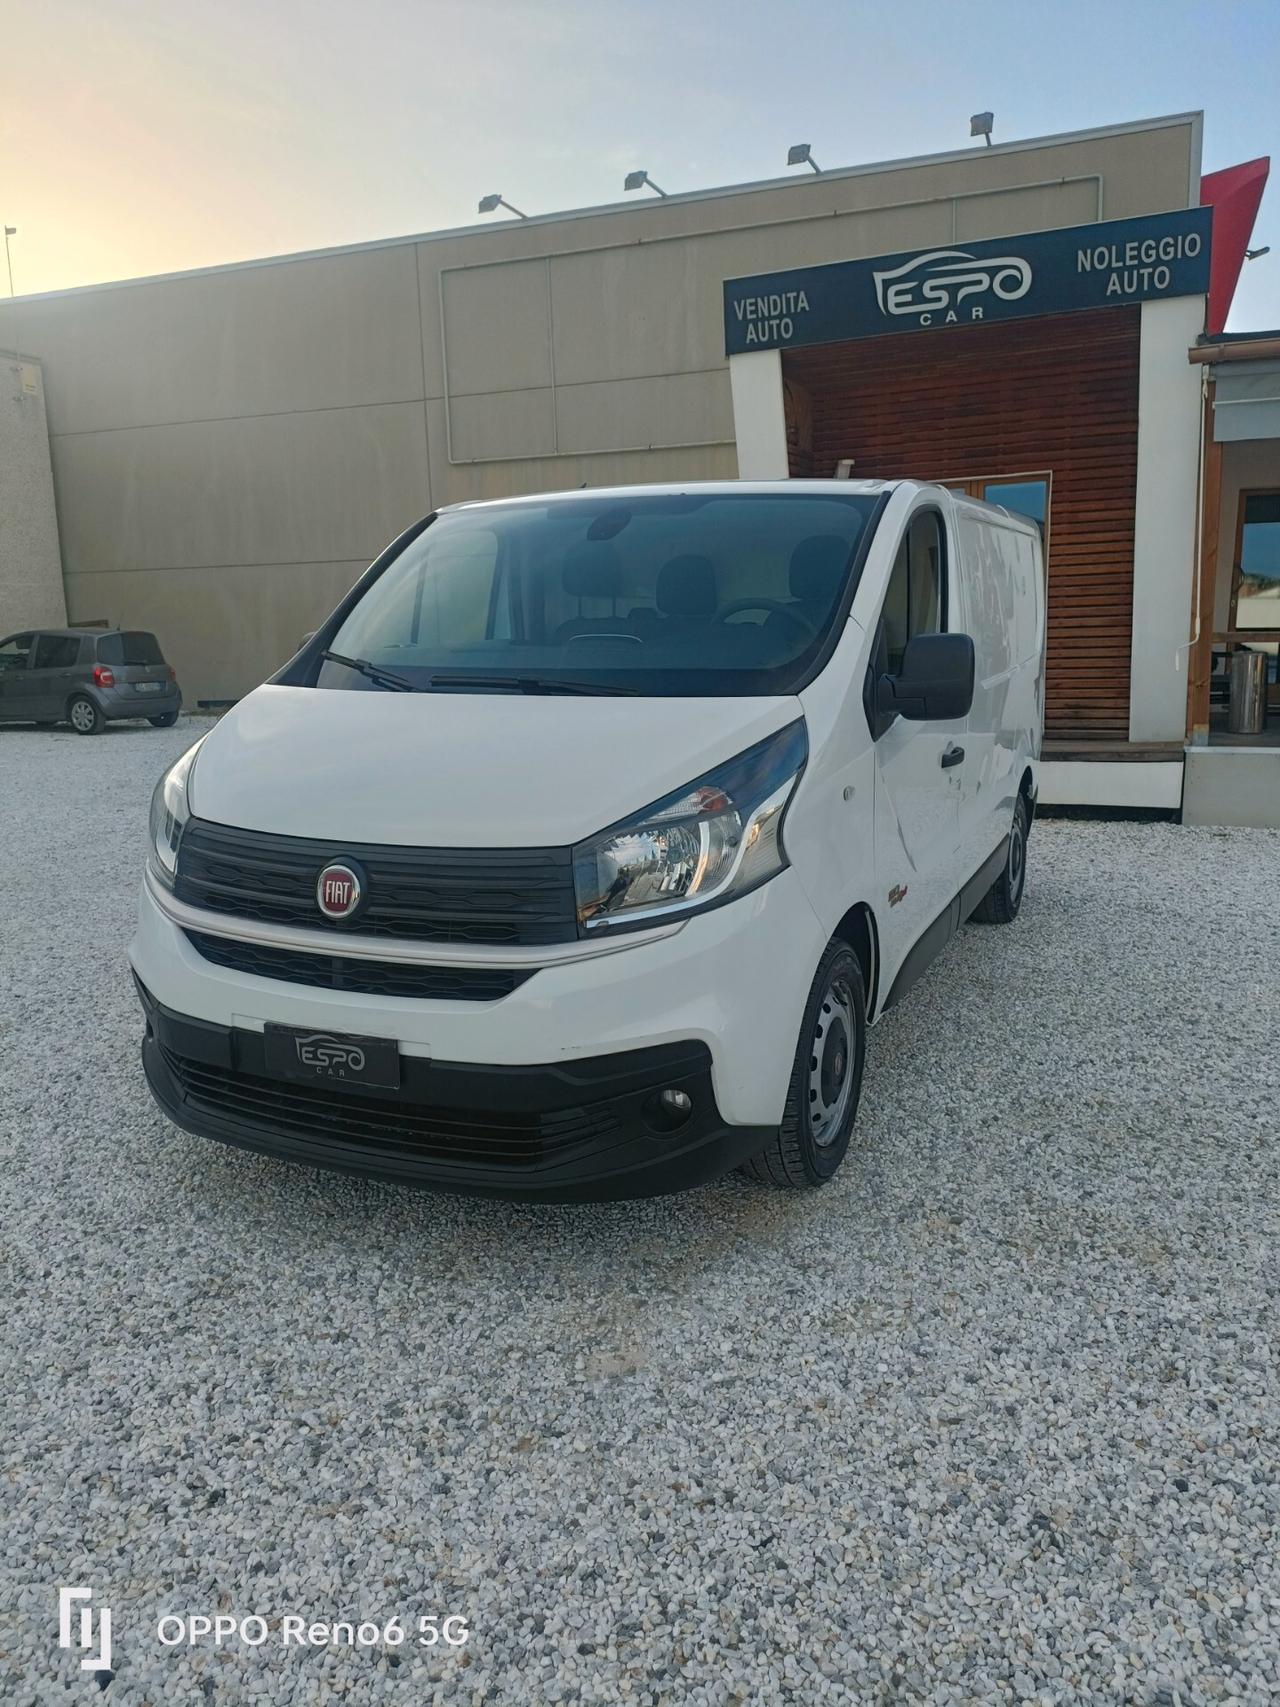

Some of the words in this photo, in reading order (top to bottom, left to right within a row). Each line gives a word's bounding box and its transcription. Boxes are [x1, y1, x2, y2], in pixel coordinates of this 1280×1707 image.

[1077, 233, 1202, 272] NOLEGGIO
[1106, 267, 1171, 296] AUTO
[733, 290, 810, 321] VENDITA
[919, 306, 984, 327] CAR
[745, 319, 794, 344] AUTO
[325, 880, 350, 904] FIAT
[316, 1066, 345, 1077] CAR
